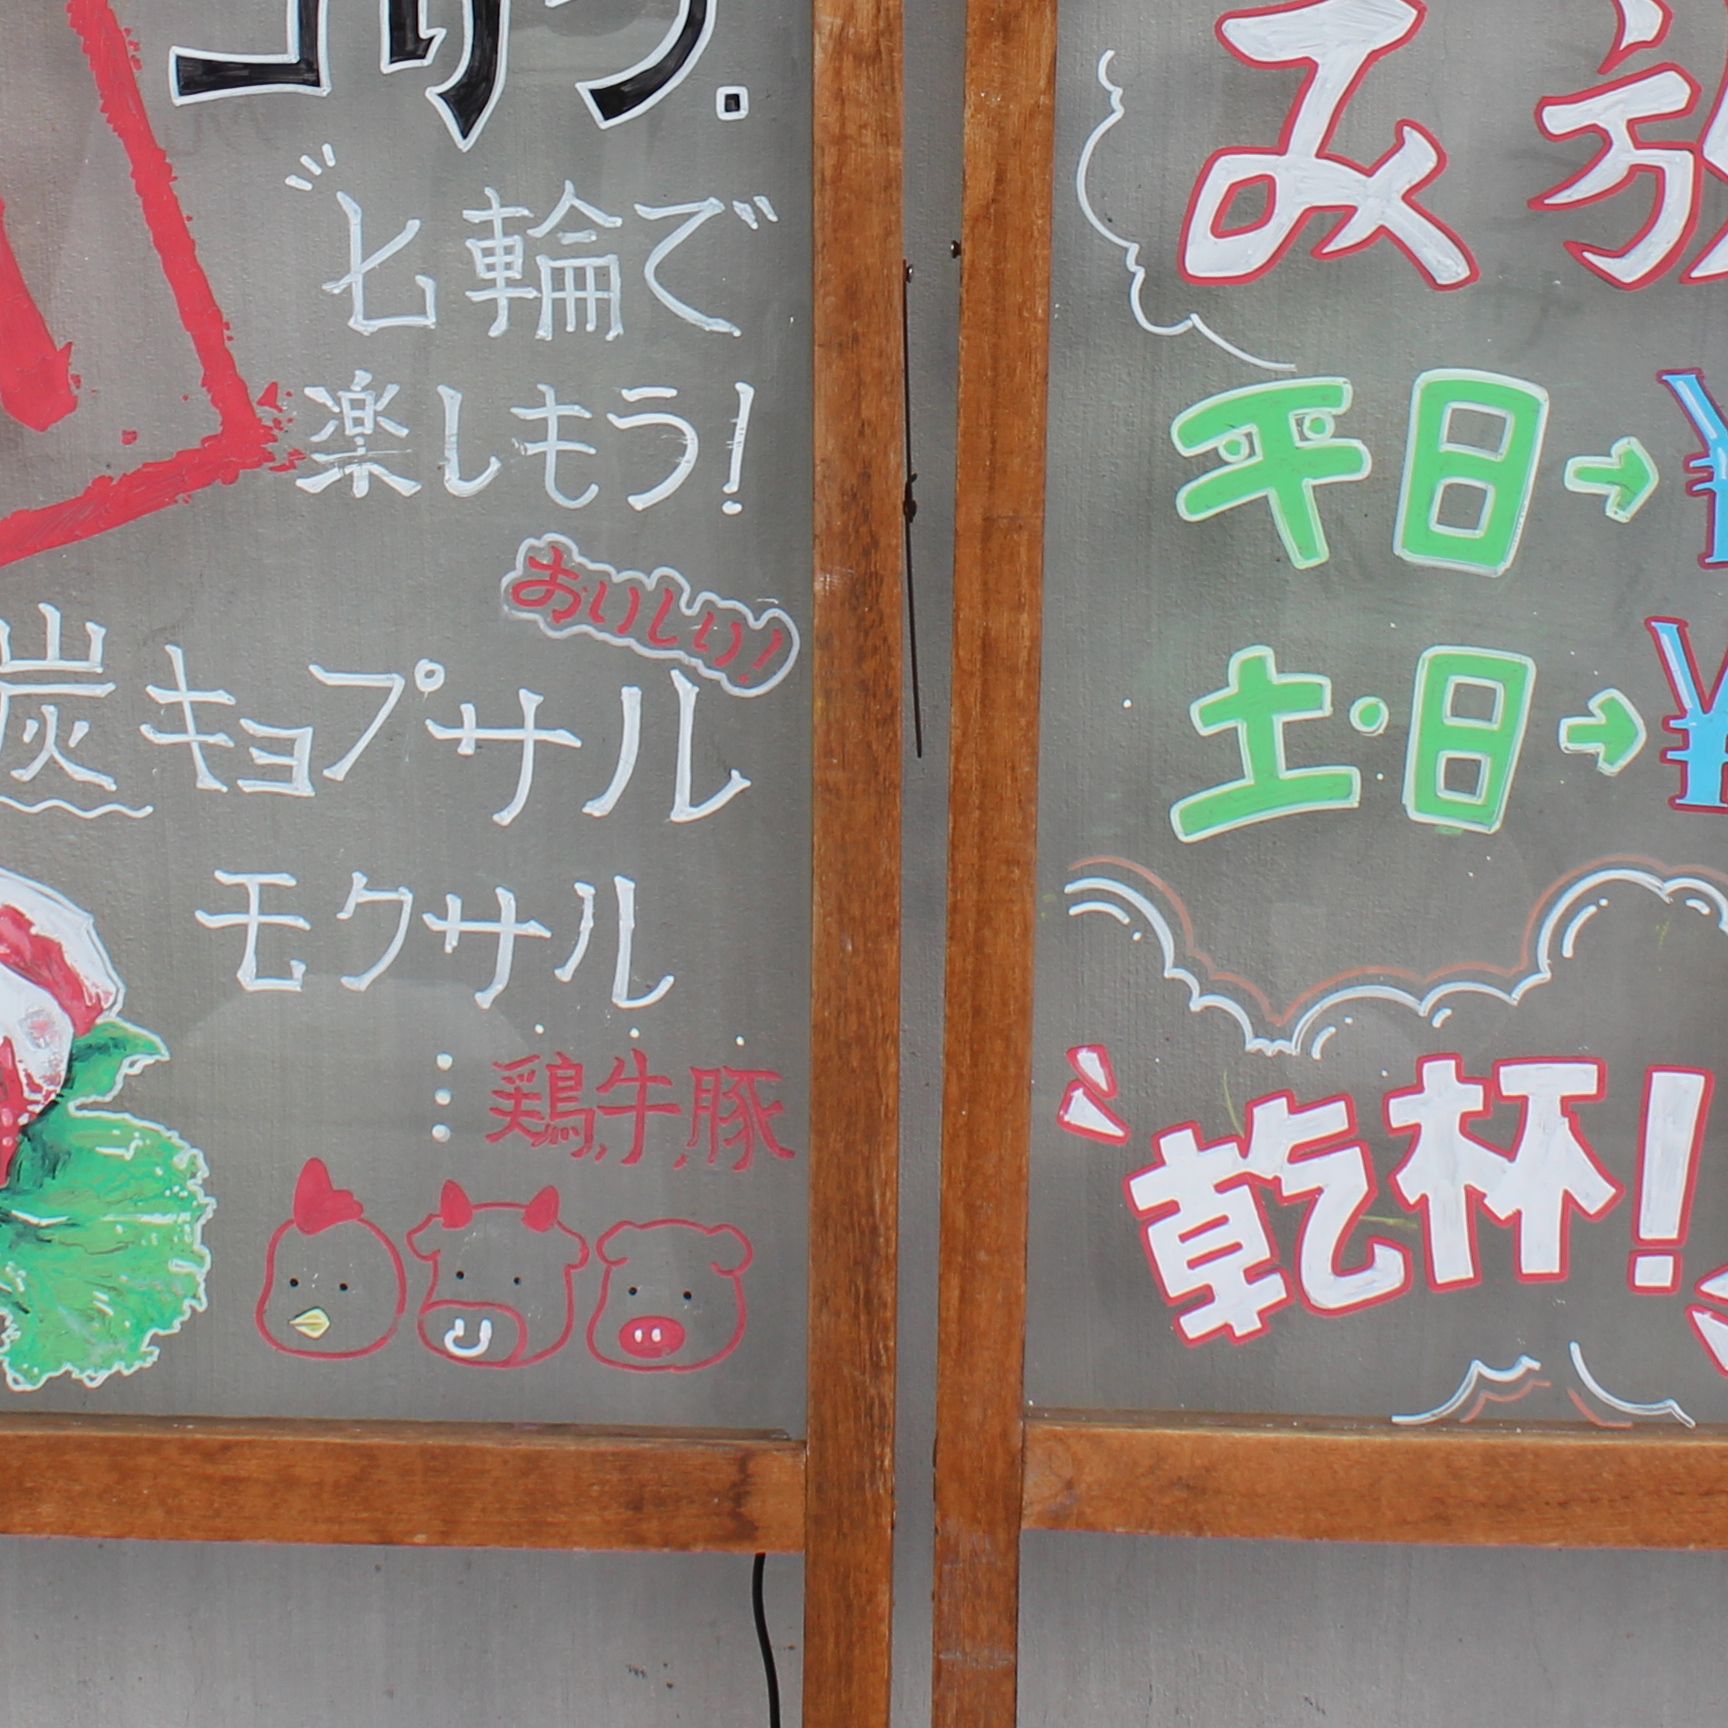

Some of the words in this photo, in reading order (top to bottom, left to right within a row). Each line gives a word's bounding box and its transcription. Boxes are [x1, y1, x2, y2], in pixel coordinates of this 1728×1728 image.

[295, 369, 755, 515] 楽しもう!
[1170, 366, 1550, 578] 平日
[510, 544, 785, 685] おいしい!
[194, 869, 675, 1009] モクサル
[1123, 1053, 1715, 1347] 乾杯!
